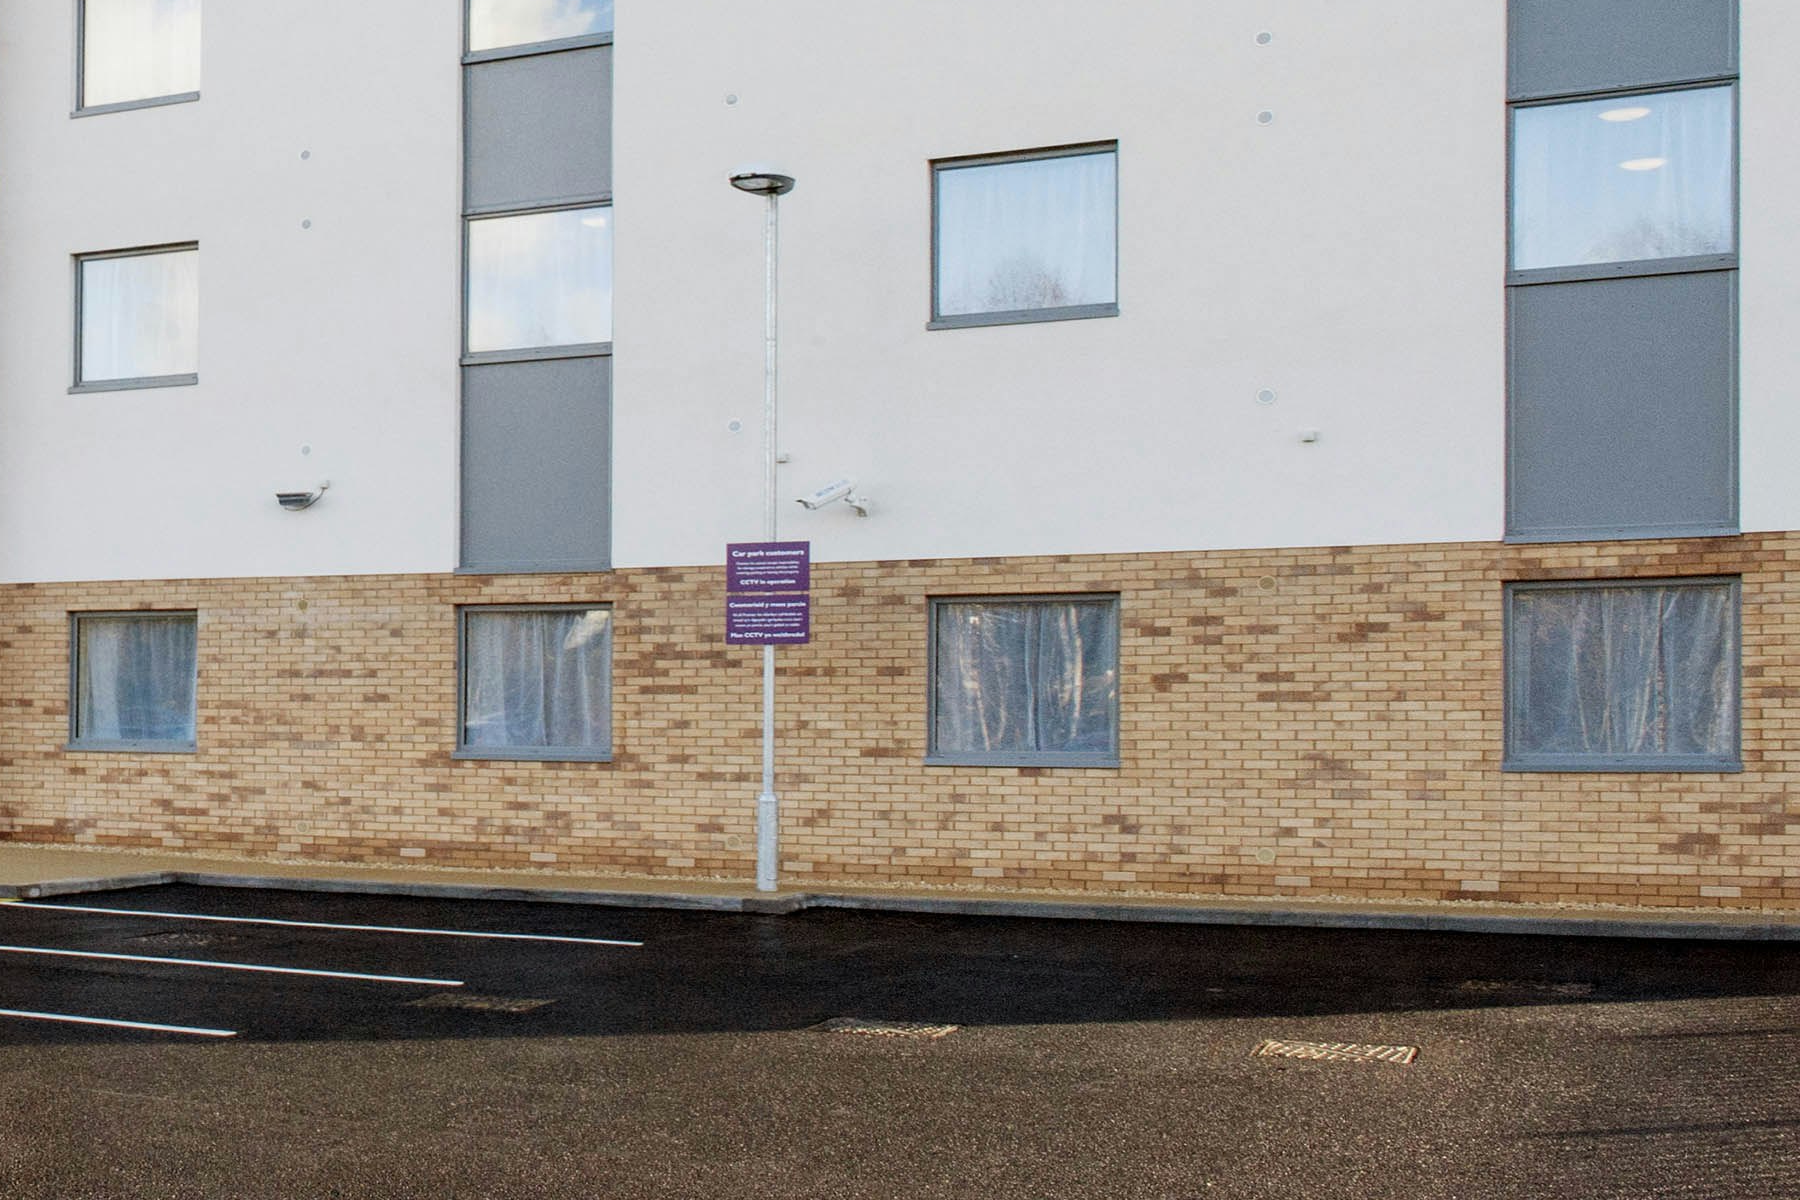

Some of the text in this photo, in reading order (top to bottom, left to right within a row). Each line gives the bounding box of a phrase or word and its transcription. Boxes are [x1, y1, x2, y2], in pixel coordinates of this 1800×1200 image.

[732, 549, 805, 558] Car park customers
[767, 578, 796, 586] operation
